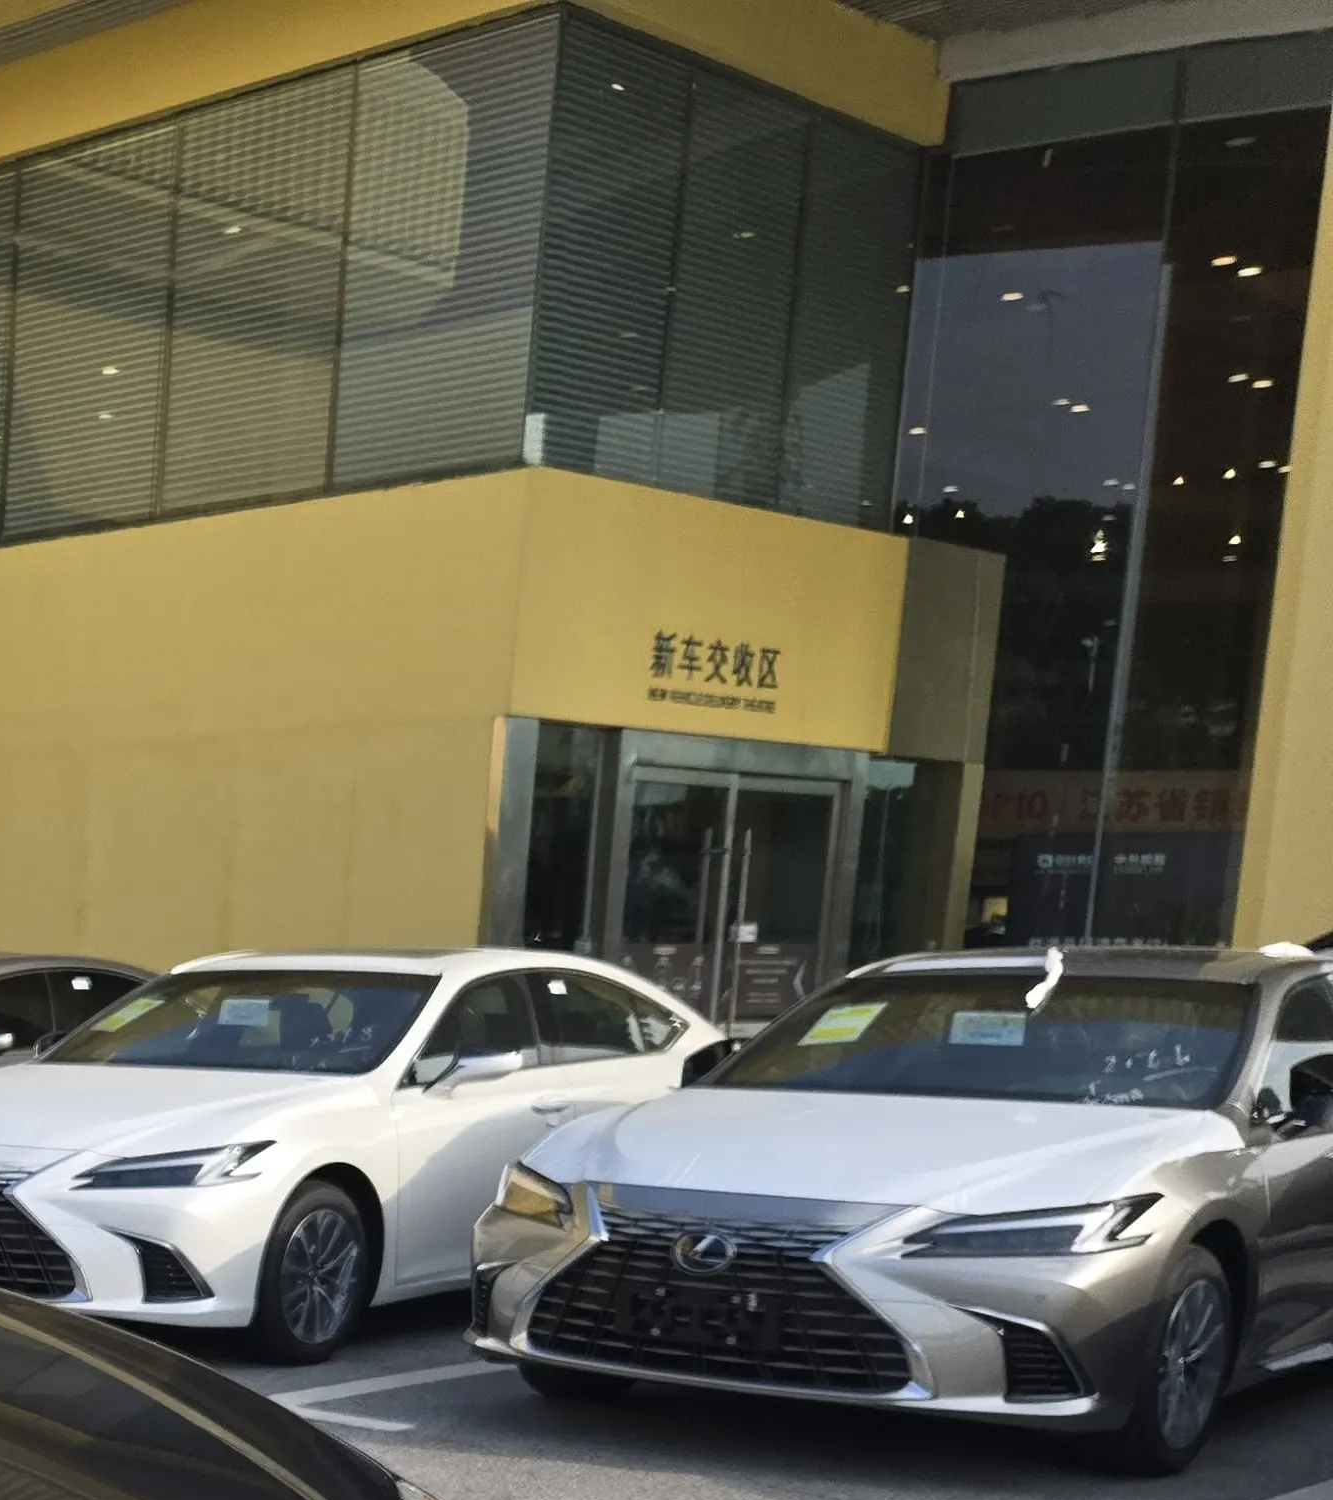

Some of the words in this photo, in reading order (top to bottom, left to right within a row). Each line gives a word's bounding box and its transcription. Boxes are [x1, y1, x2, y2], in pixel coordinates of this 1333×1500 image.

[649, 629, 782, 690] 新车交收区
